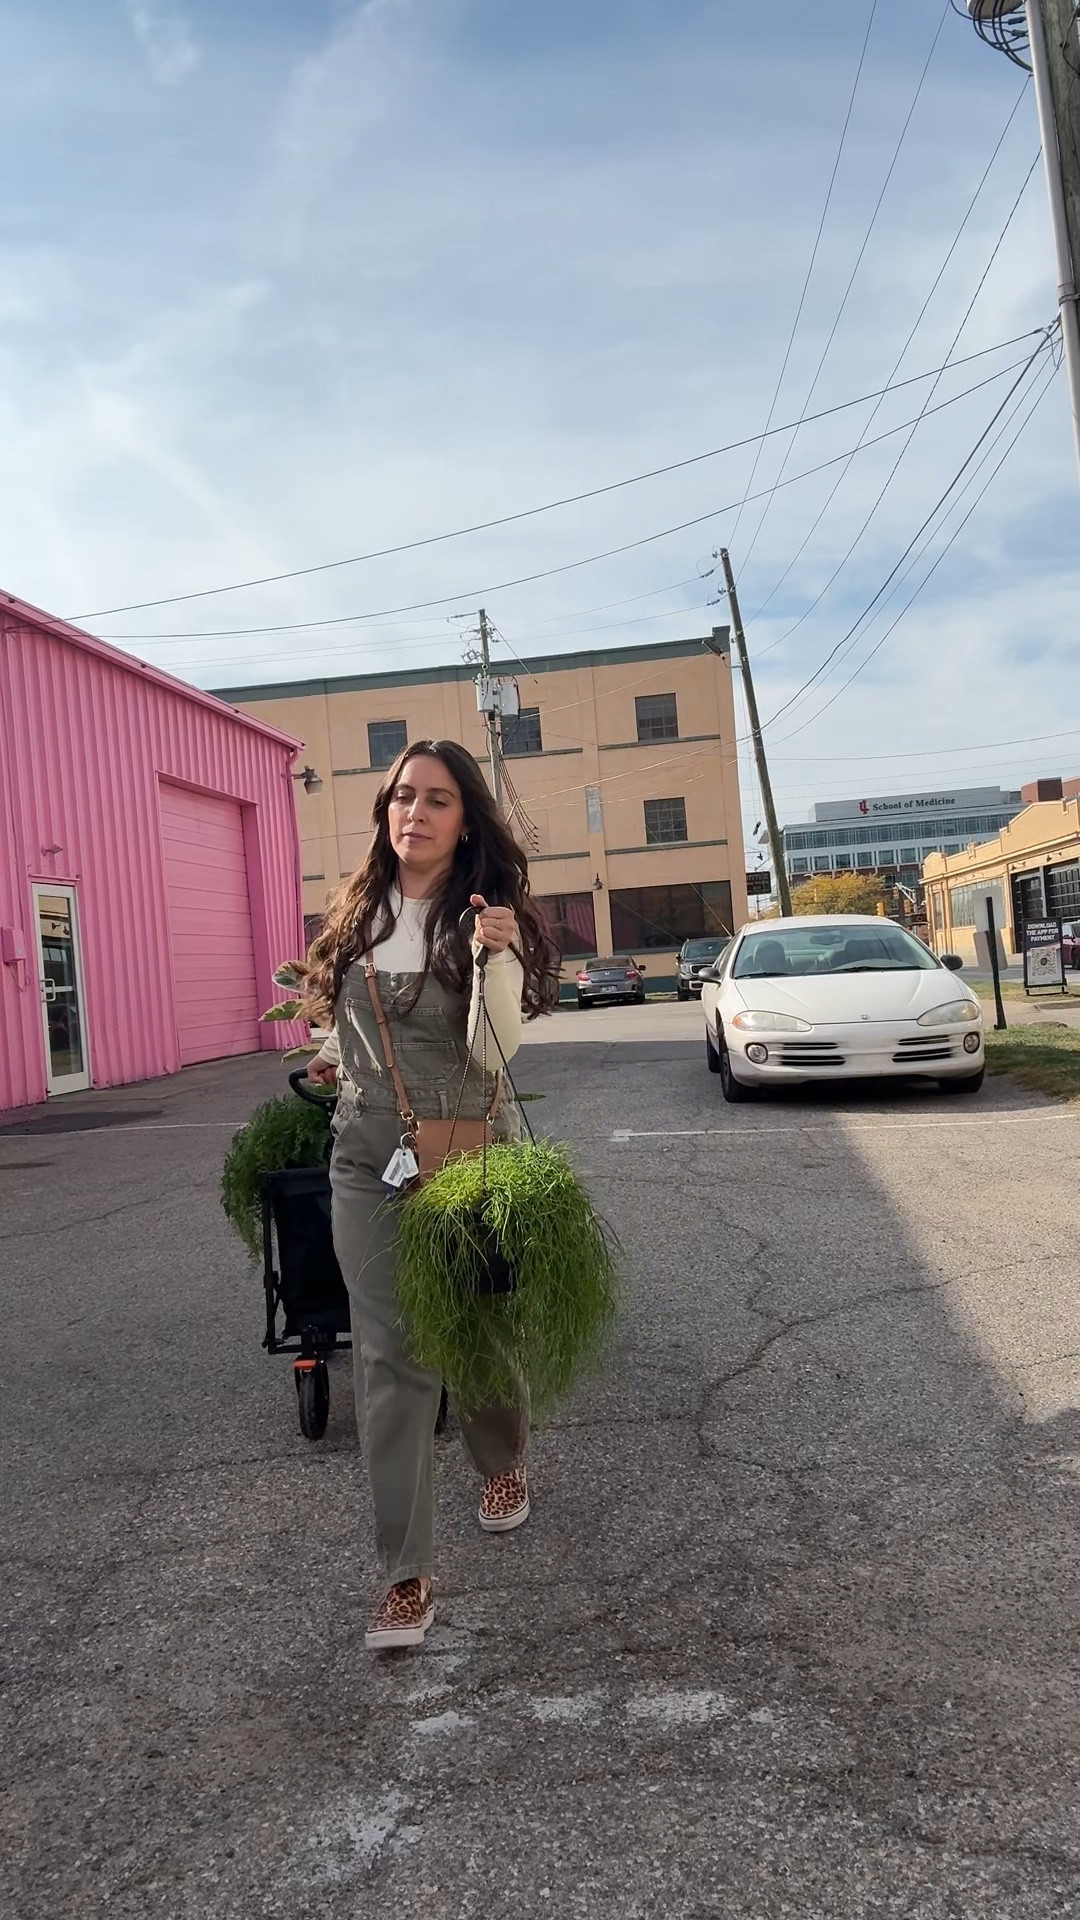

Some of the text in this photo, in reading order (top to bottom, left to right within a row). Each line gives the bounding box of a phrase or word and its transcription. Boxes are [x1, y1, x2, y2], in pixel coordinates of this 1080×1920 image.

[873, 803, 901, 811] School
[904, 800, 913, 808] of
[916, 798, 955, 807] Medicine
